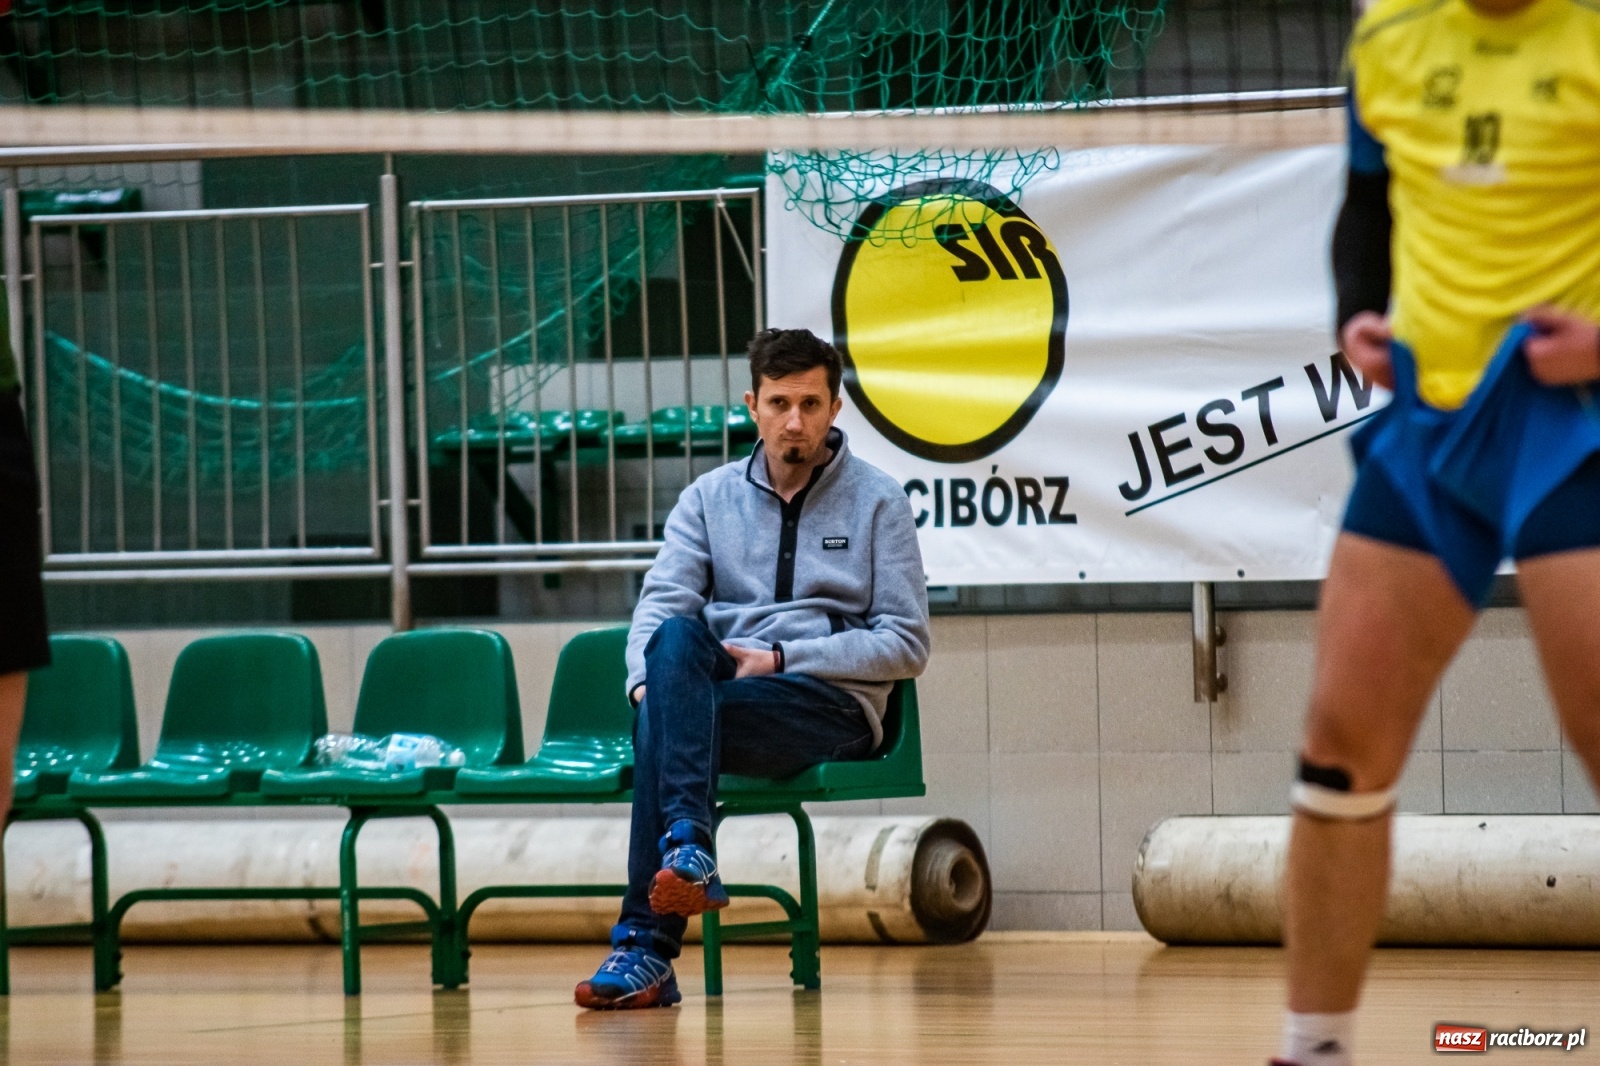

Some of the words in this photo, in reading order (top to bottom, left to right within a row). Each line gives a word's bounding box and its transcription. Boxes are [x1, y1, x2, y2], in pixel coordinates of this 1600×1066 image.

[934, 220, 1057, 282] SIR
[1118, 375, 1284, 502] JEST
[1303, 350, 1375, 423] W
